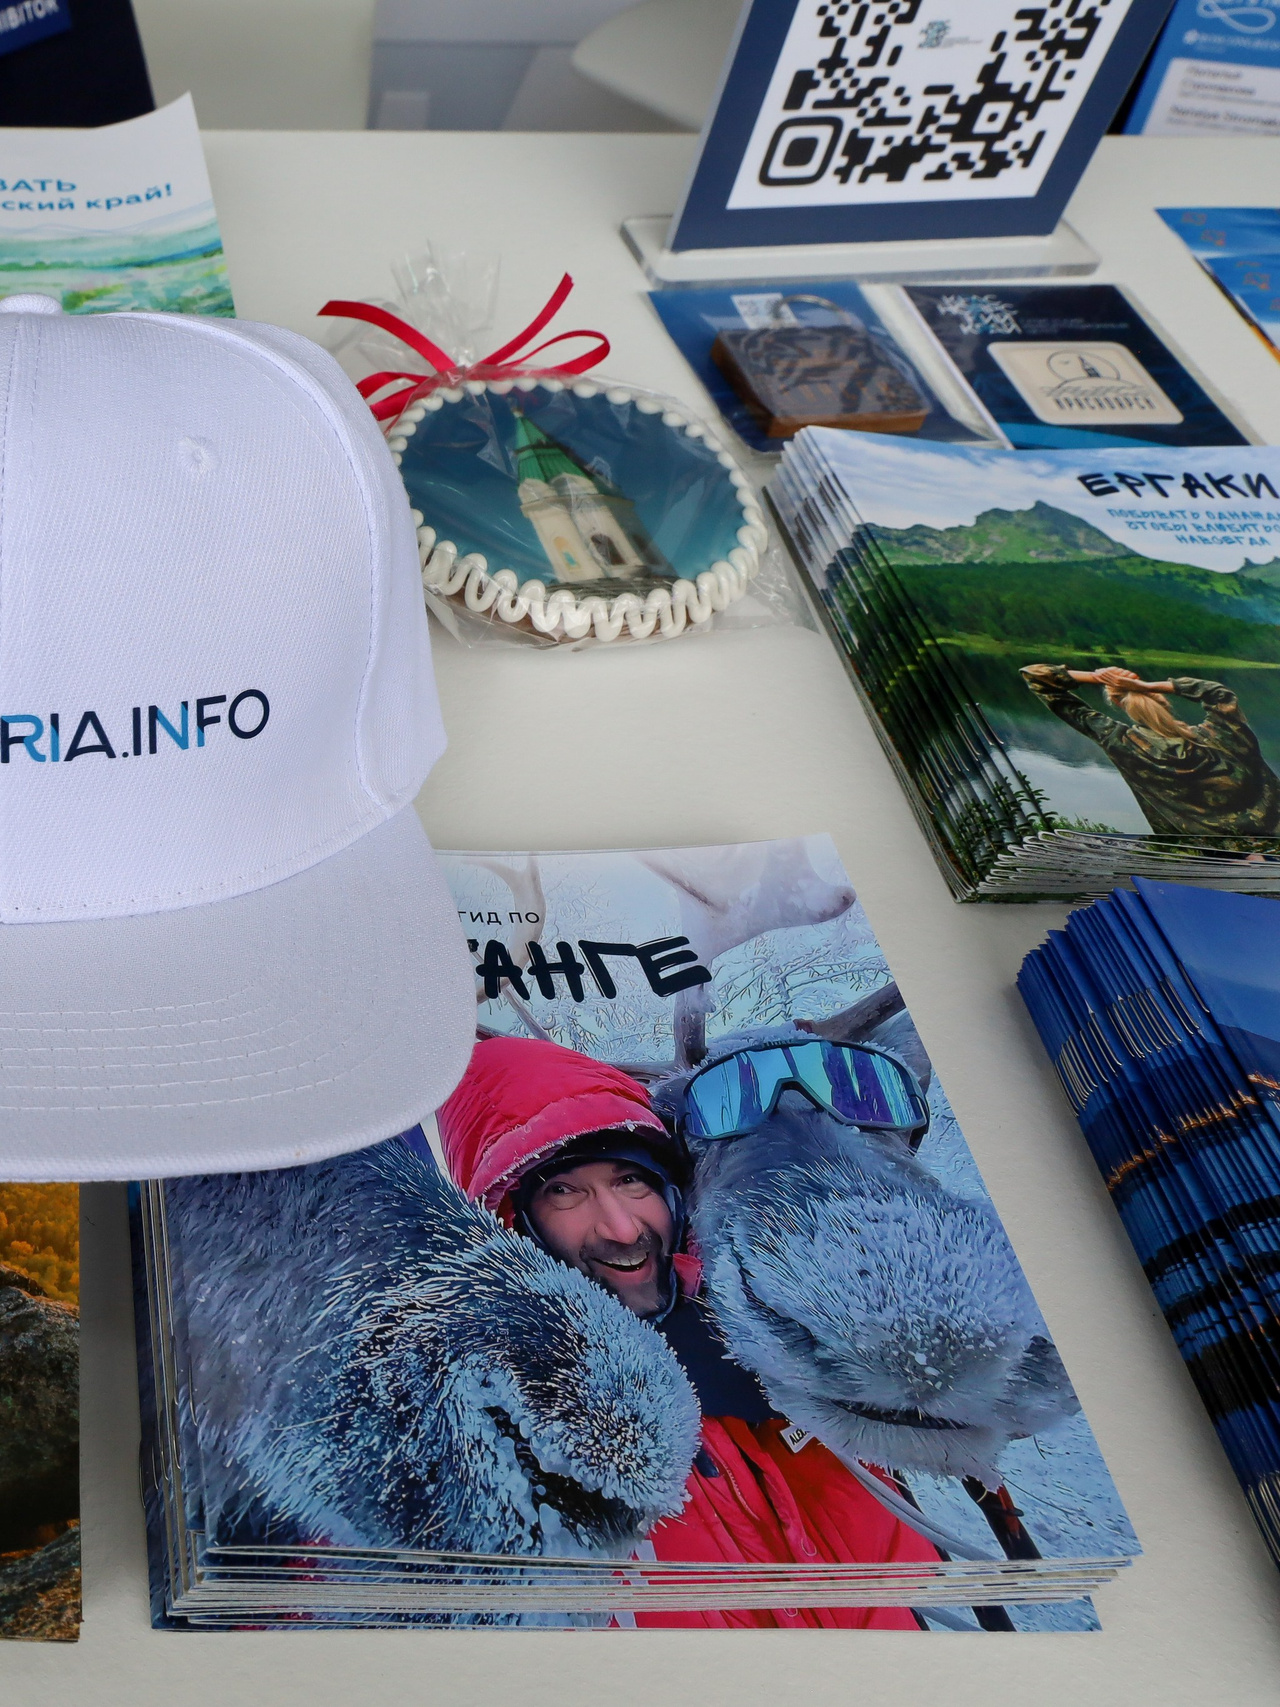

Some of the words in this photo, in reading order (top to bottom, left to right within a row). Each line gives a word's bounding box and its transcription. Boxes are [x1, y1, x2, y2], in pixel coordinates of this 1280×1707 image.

[86, 182, 172, 211] край!
[1077, 472, 1280, 499] ЕРГАКИ
[467, 936, 713, 1003] АНГЕ
